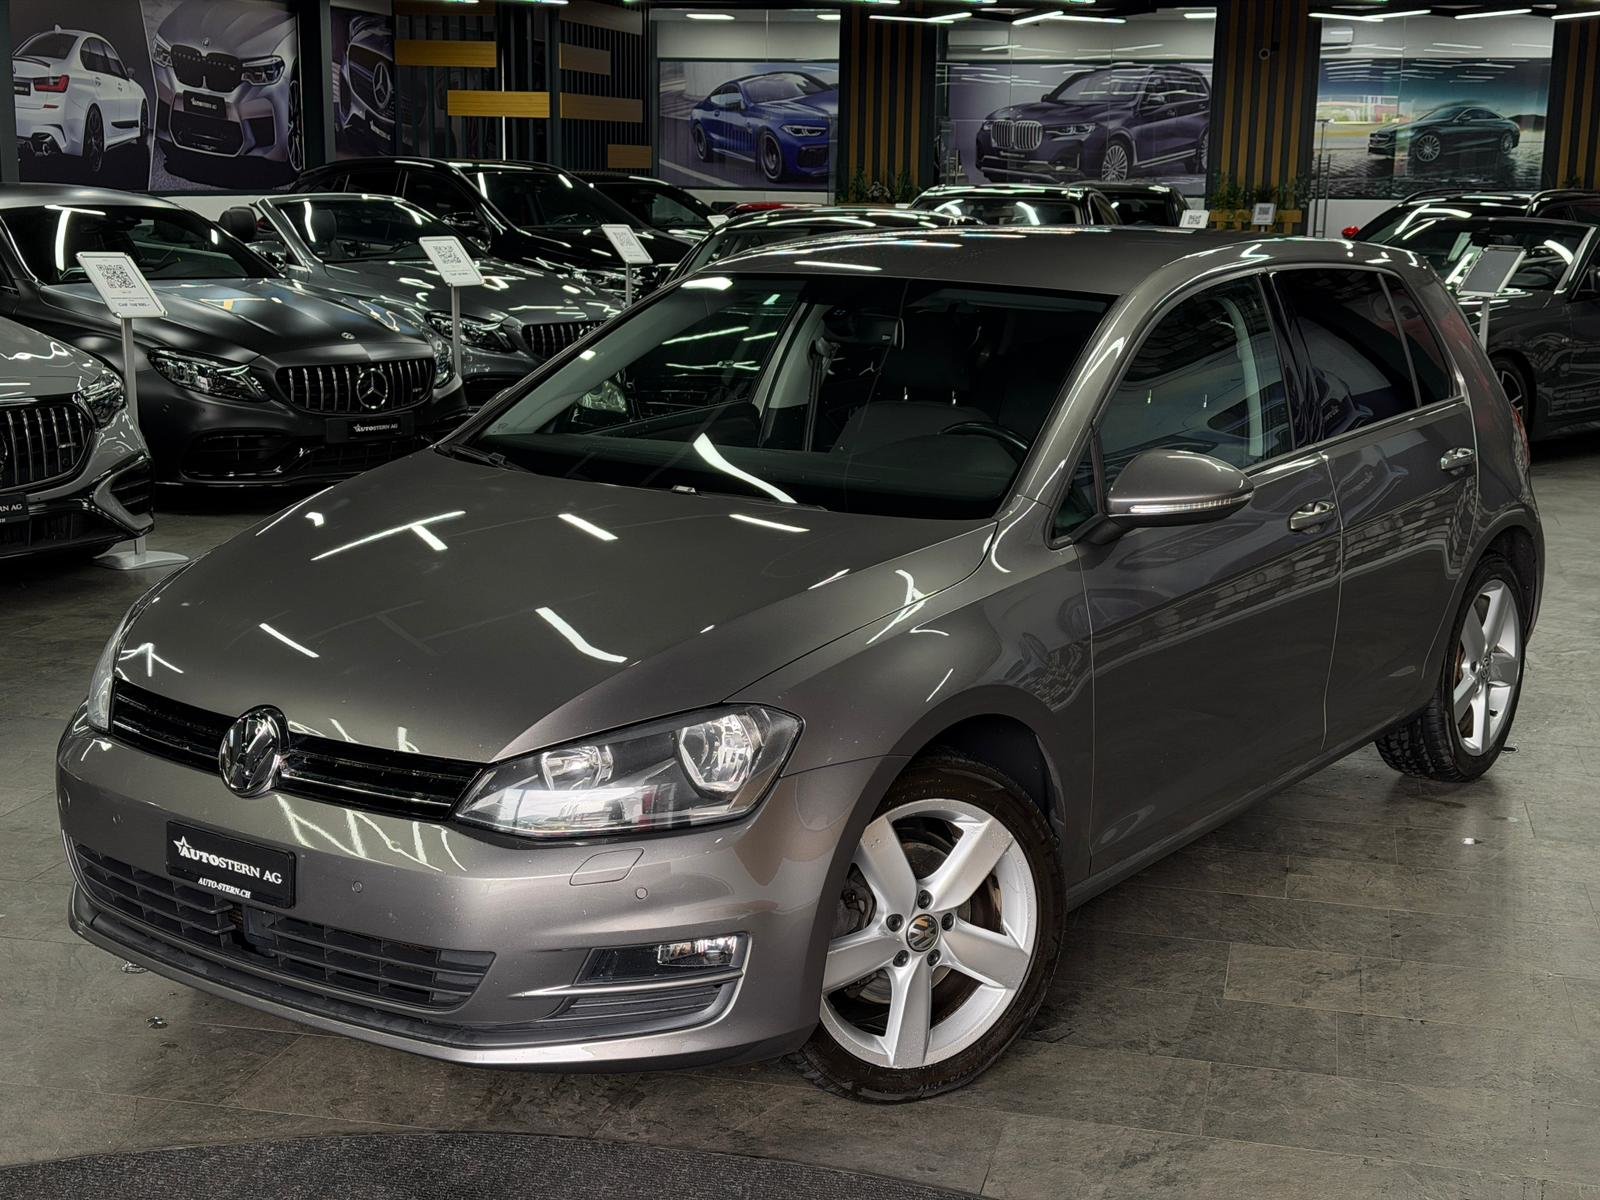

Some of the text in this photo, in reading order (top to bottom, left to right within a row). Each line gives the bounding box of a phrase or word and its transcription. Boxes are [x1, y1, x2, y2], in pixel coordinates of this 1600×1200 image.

[11, 503, 23, 511] AG
[179, 844, 283, 885] AUTOSTERN AG
[198, 877, 252, 899] AUTO-STERN.CH
